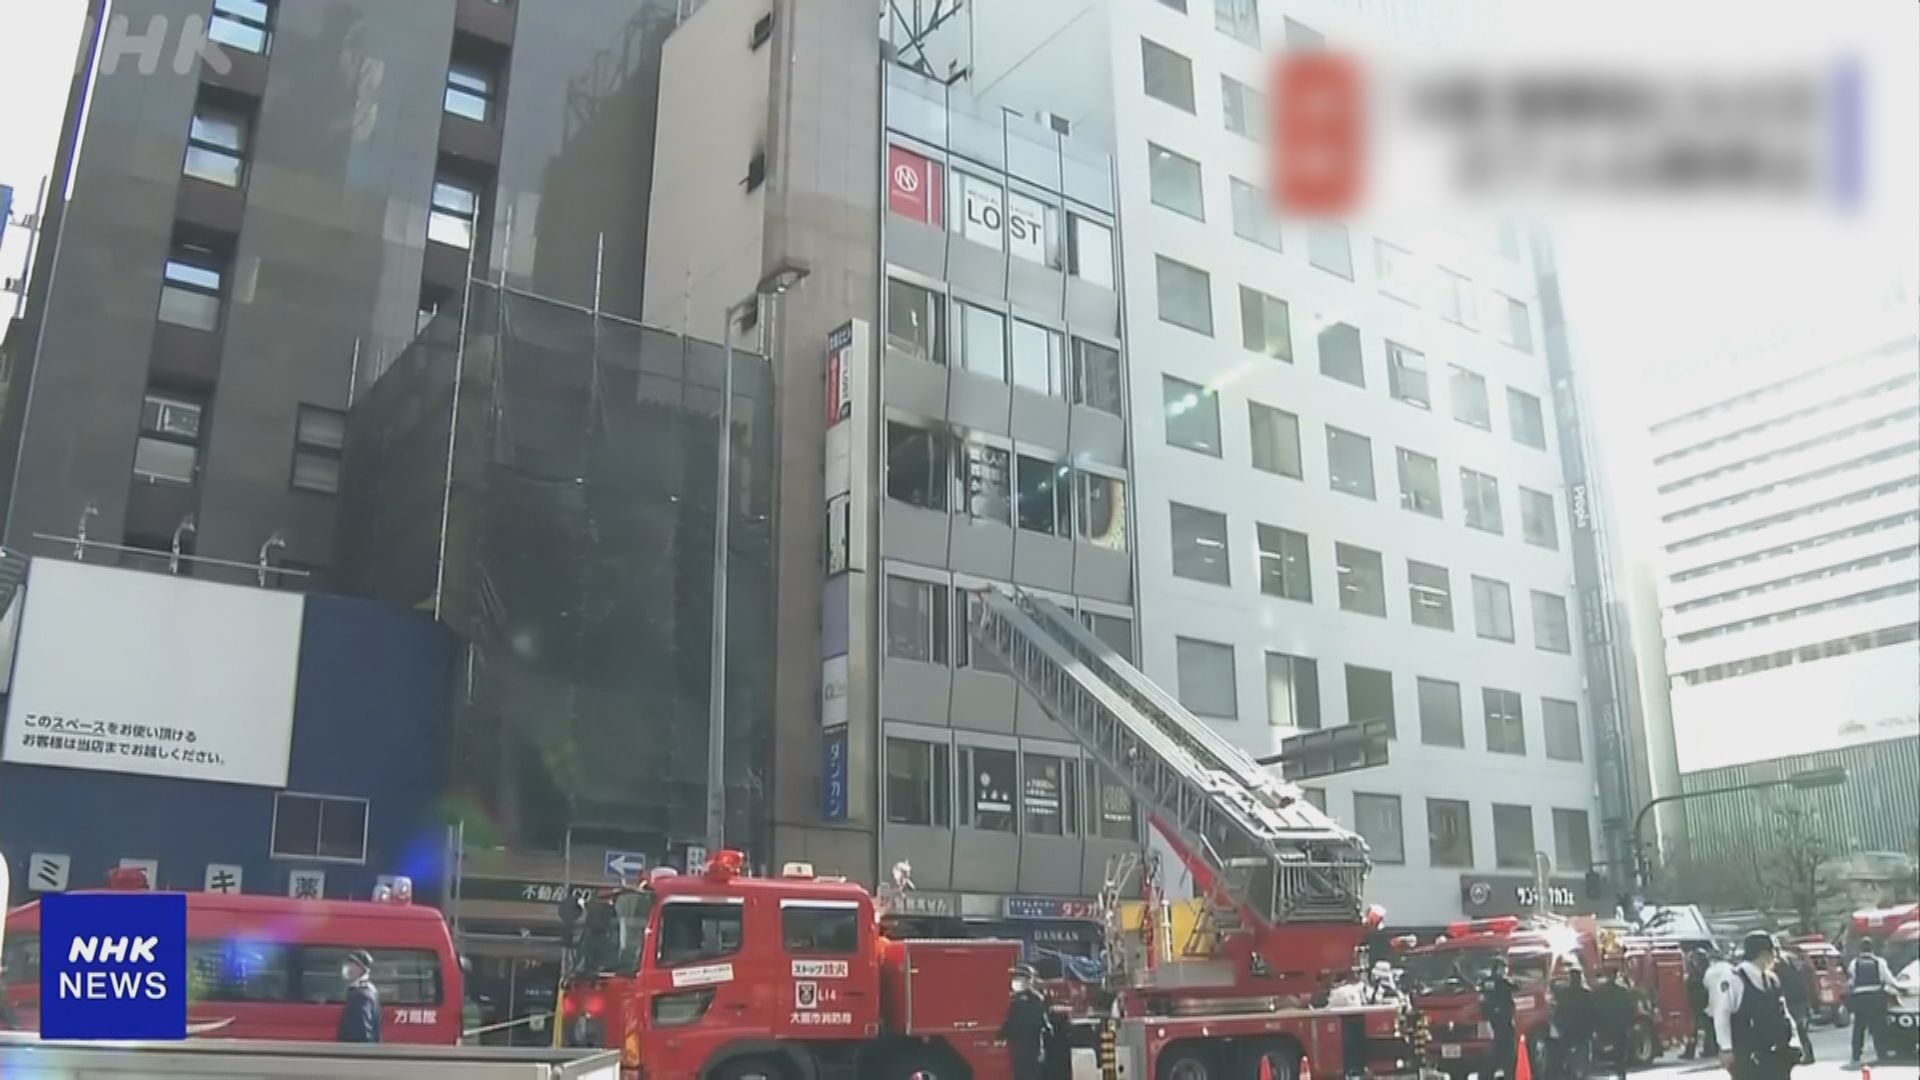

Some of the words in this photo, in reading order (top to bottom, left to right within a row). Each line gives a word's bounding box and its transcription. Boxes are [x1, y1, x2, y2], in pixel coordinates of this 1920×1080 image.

[967, 197, 1041, 245] LOST
[24, 713, 197, 743] このスペースをお使い頂ける
[21, 733, 226, 765] お客様は当店までお越しください。
[1034, 930, 1080, 941] DANKAN
